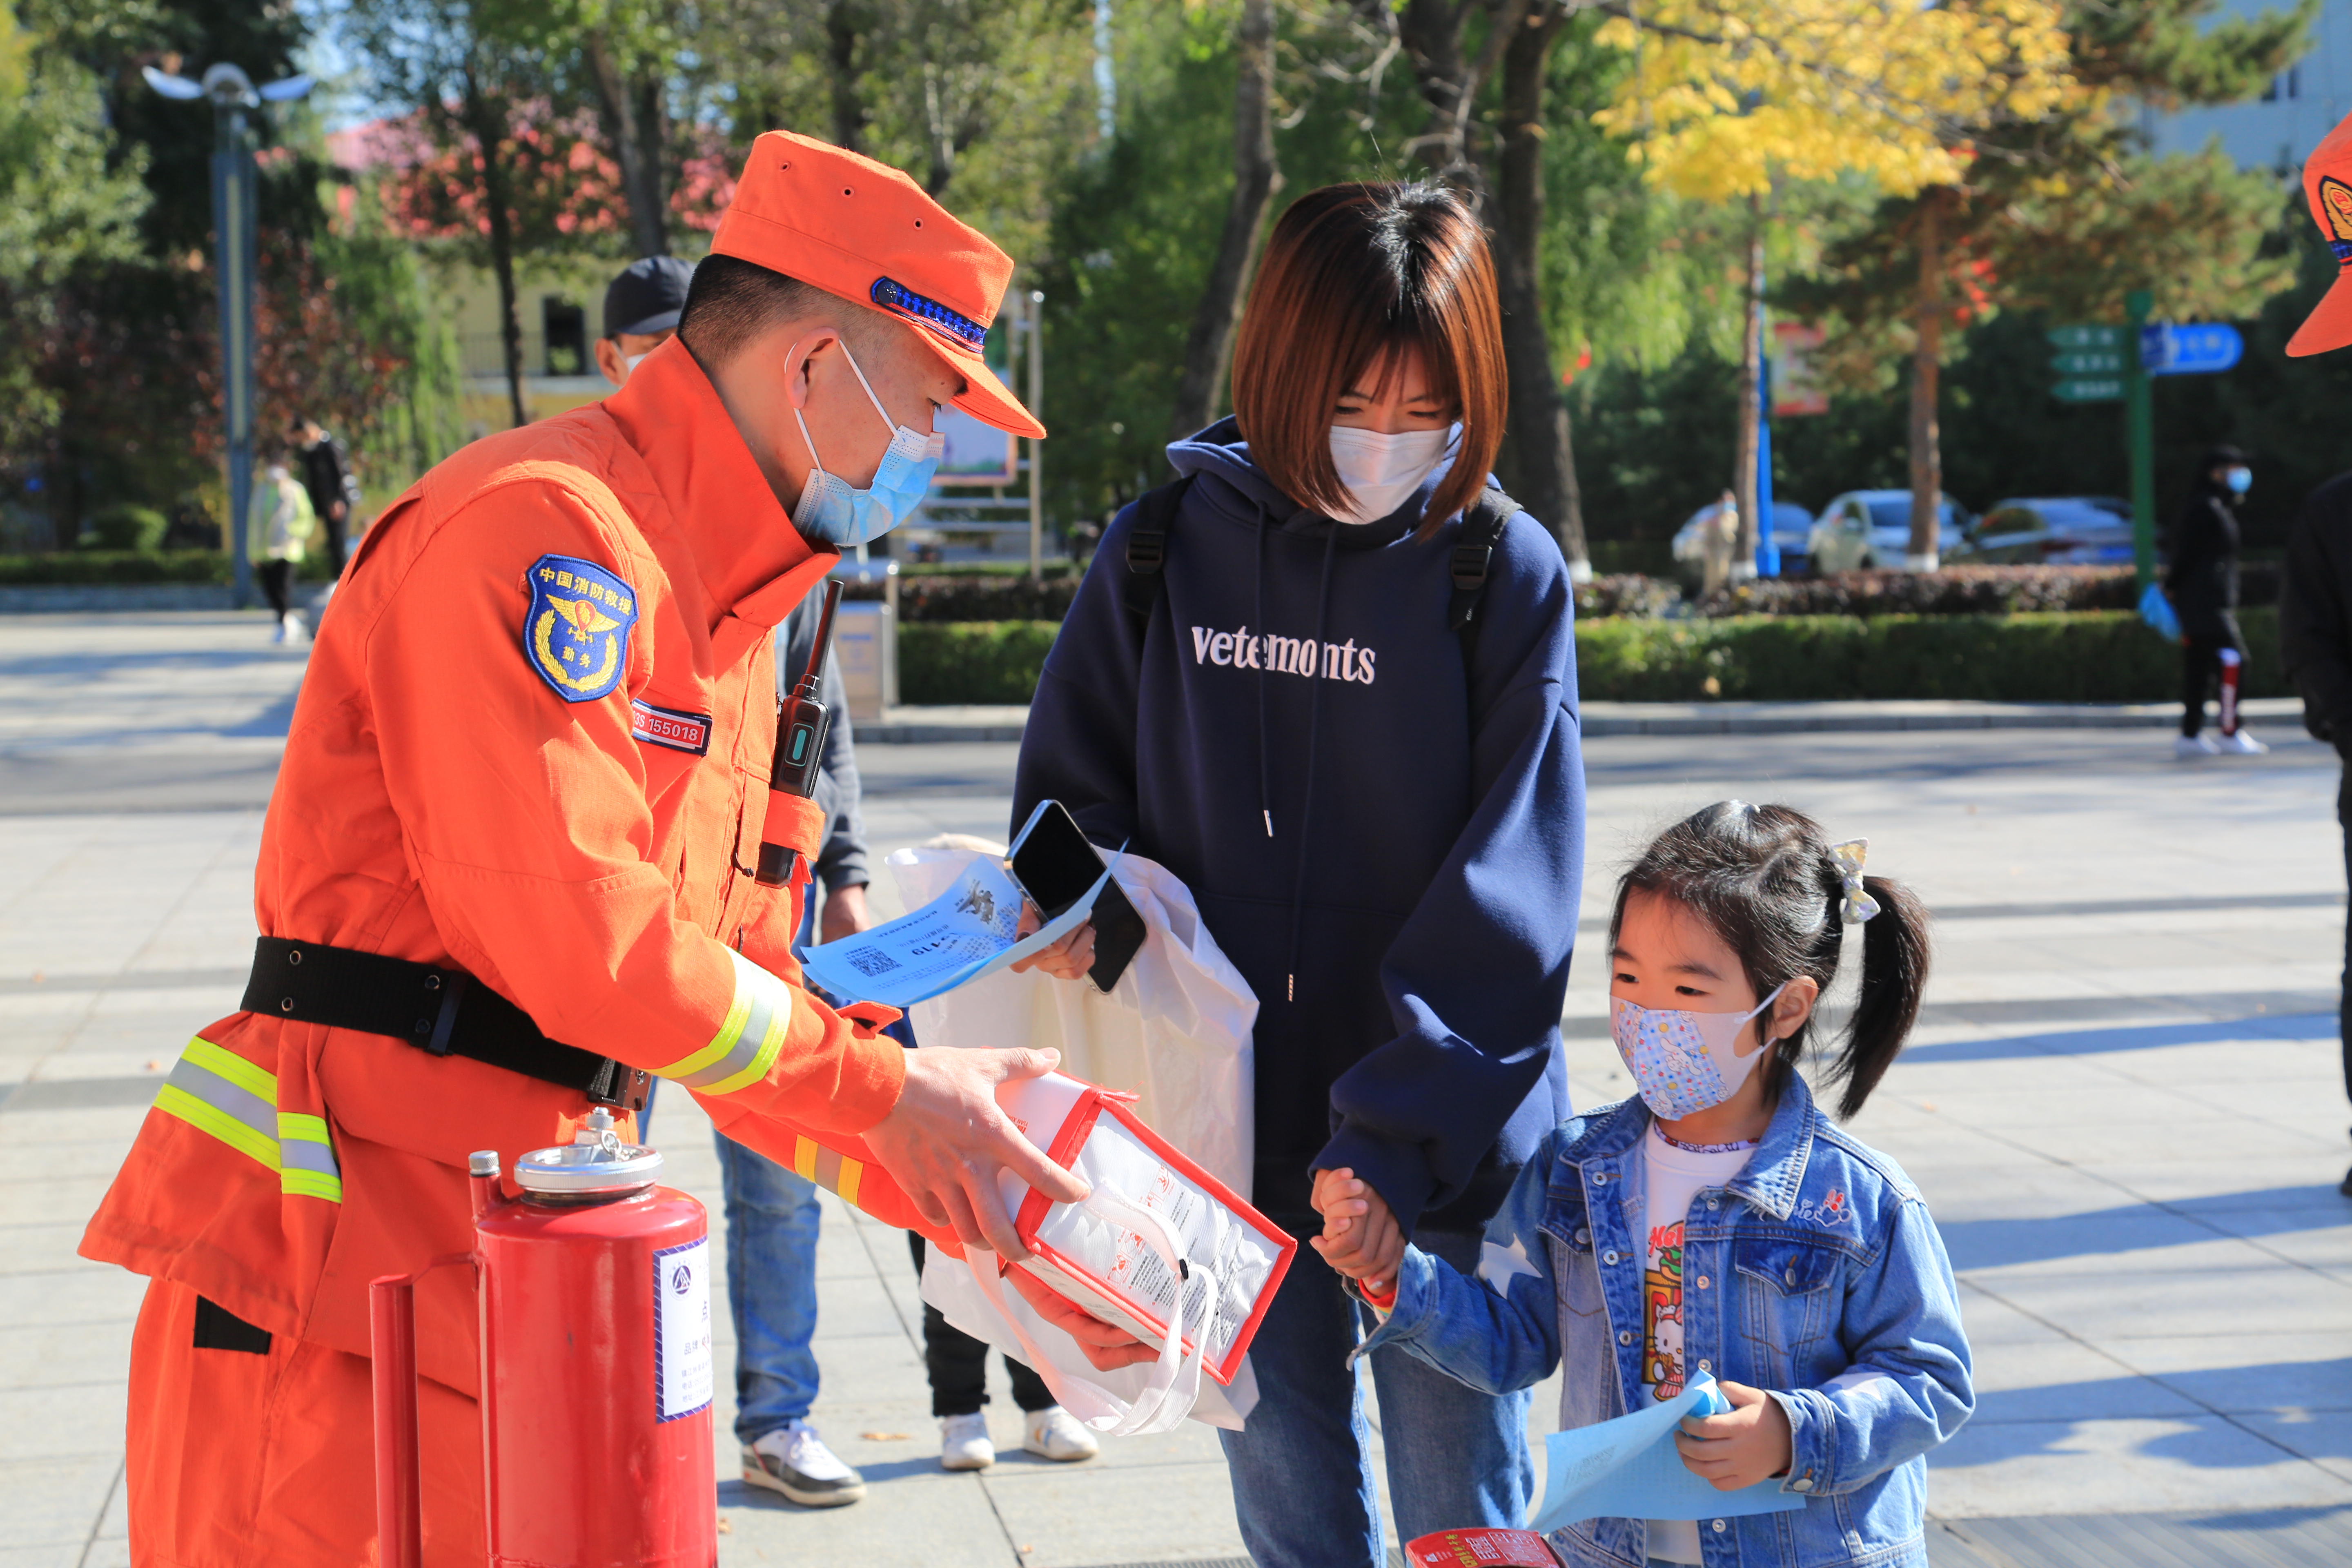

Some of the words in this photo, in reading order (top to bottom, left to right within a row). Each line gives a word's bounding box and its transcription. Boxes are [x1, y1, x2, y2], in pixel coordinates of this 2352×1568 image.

[539, 567, 633, 616] 中国消防救援
[561, 645, 592, 668] 勤务
[649, 718, 698, 742] 155018
